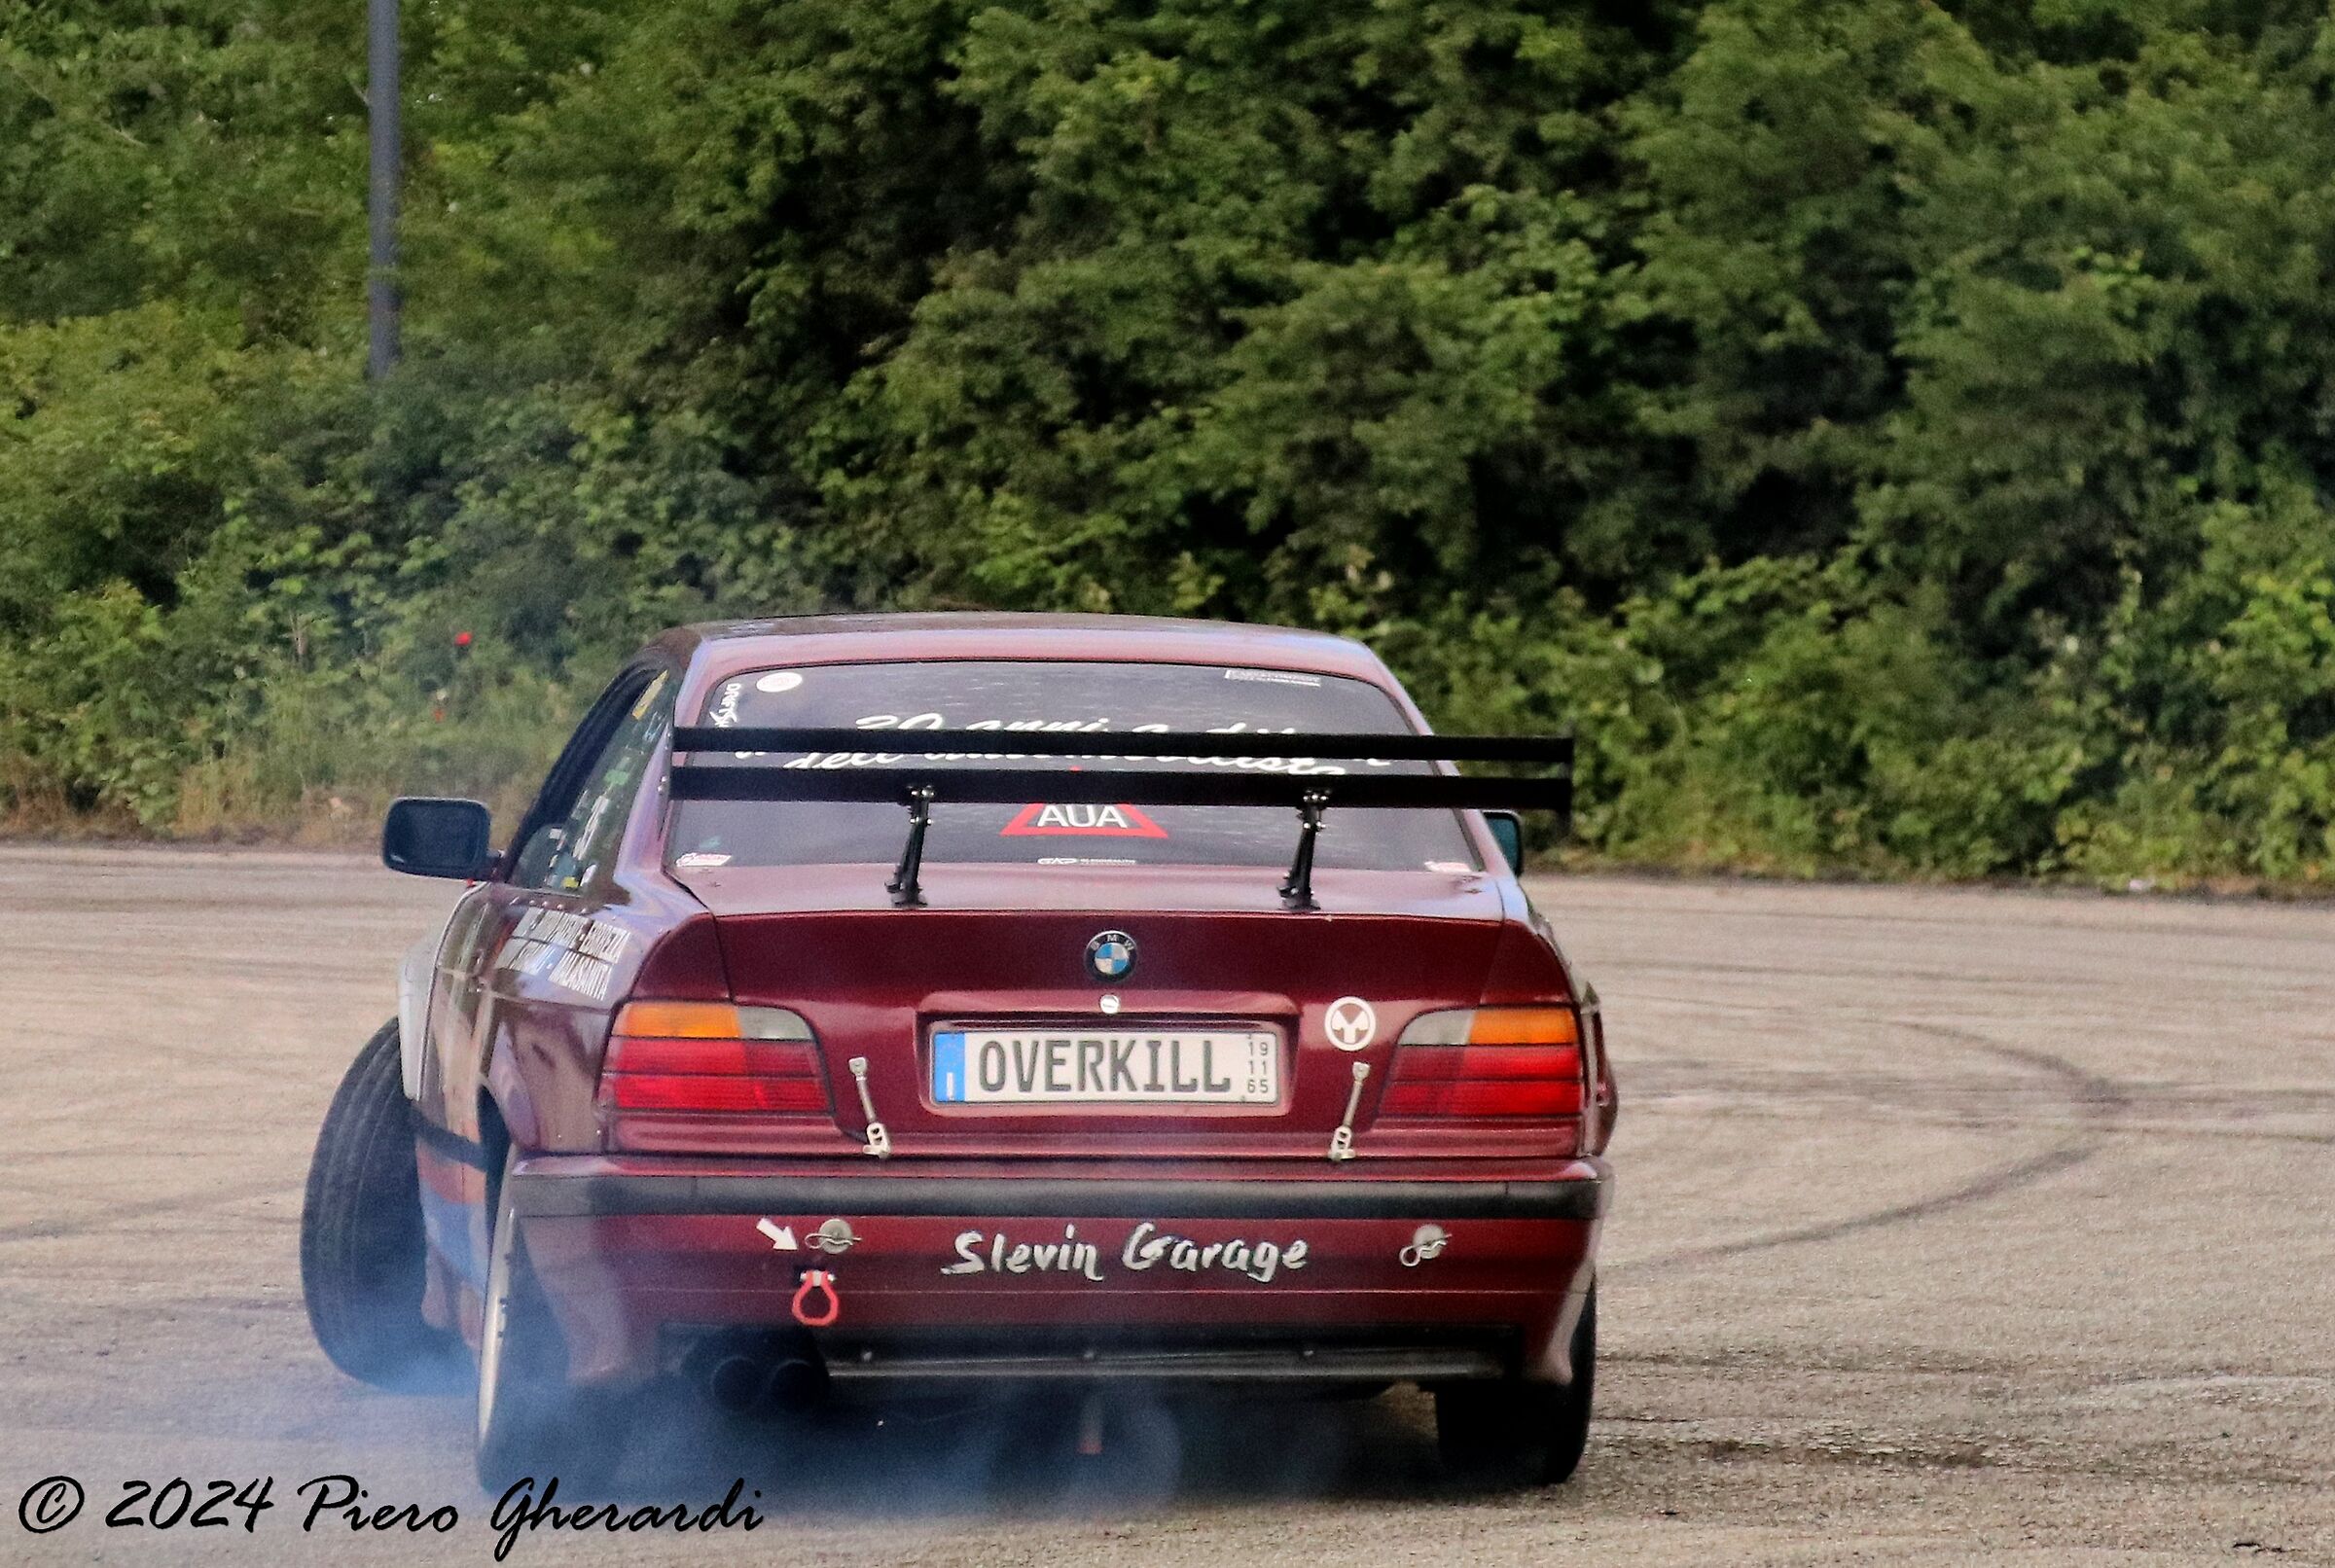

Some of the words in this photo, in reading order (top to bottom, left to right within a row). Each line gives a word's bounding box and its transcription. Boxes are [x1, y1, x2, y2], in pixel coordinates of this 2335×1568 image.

[1036, 804, 1128, 829] AUA
[1247, 1042, 1269, 1056] 19
[978, 1039, 1232, 1093] OVERKILL
[1248, 1060, 1268, 1075] 11
[1246, 1079, 1269, 1093] 65
[940, 1224, 1105, 1282] Slevin
[1121, 1222, 1309, 1283] Garage
